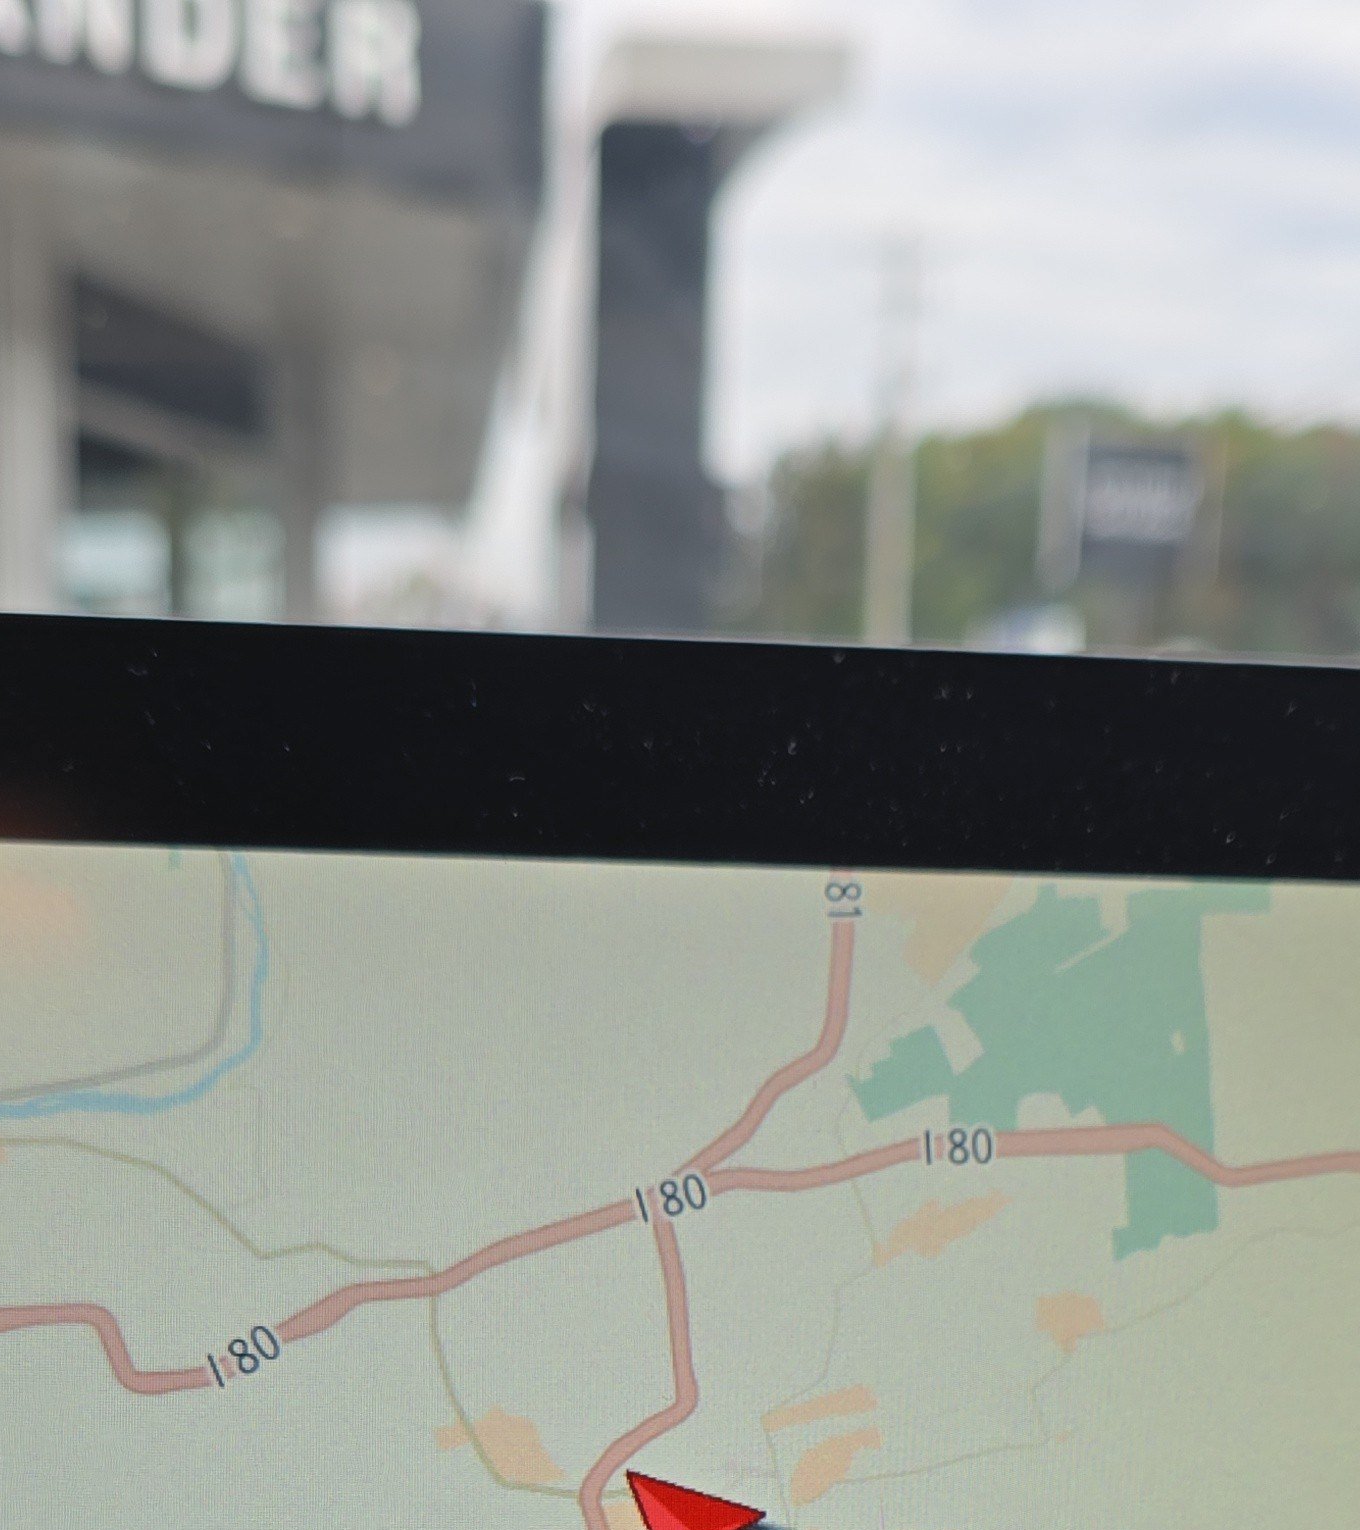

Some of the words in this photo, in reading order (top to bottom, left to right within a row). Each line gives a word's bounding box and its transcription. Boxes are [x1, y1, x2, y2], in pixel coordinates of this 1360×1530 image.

[824, 882, 862, 918] 81
[948, 1128, 993, 1165] 80
[660, 1173, 707, 1216] 80
[228, 1325, 280, 1374] 80
